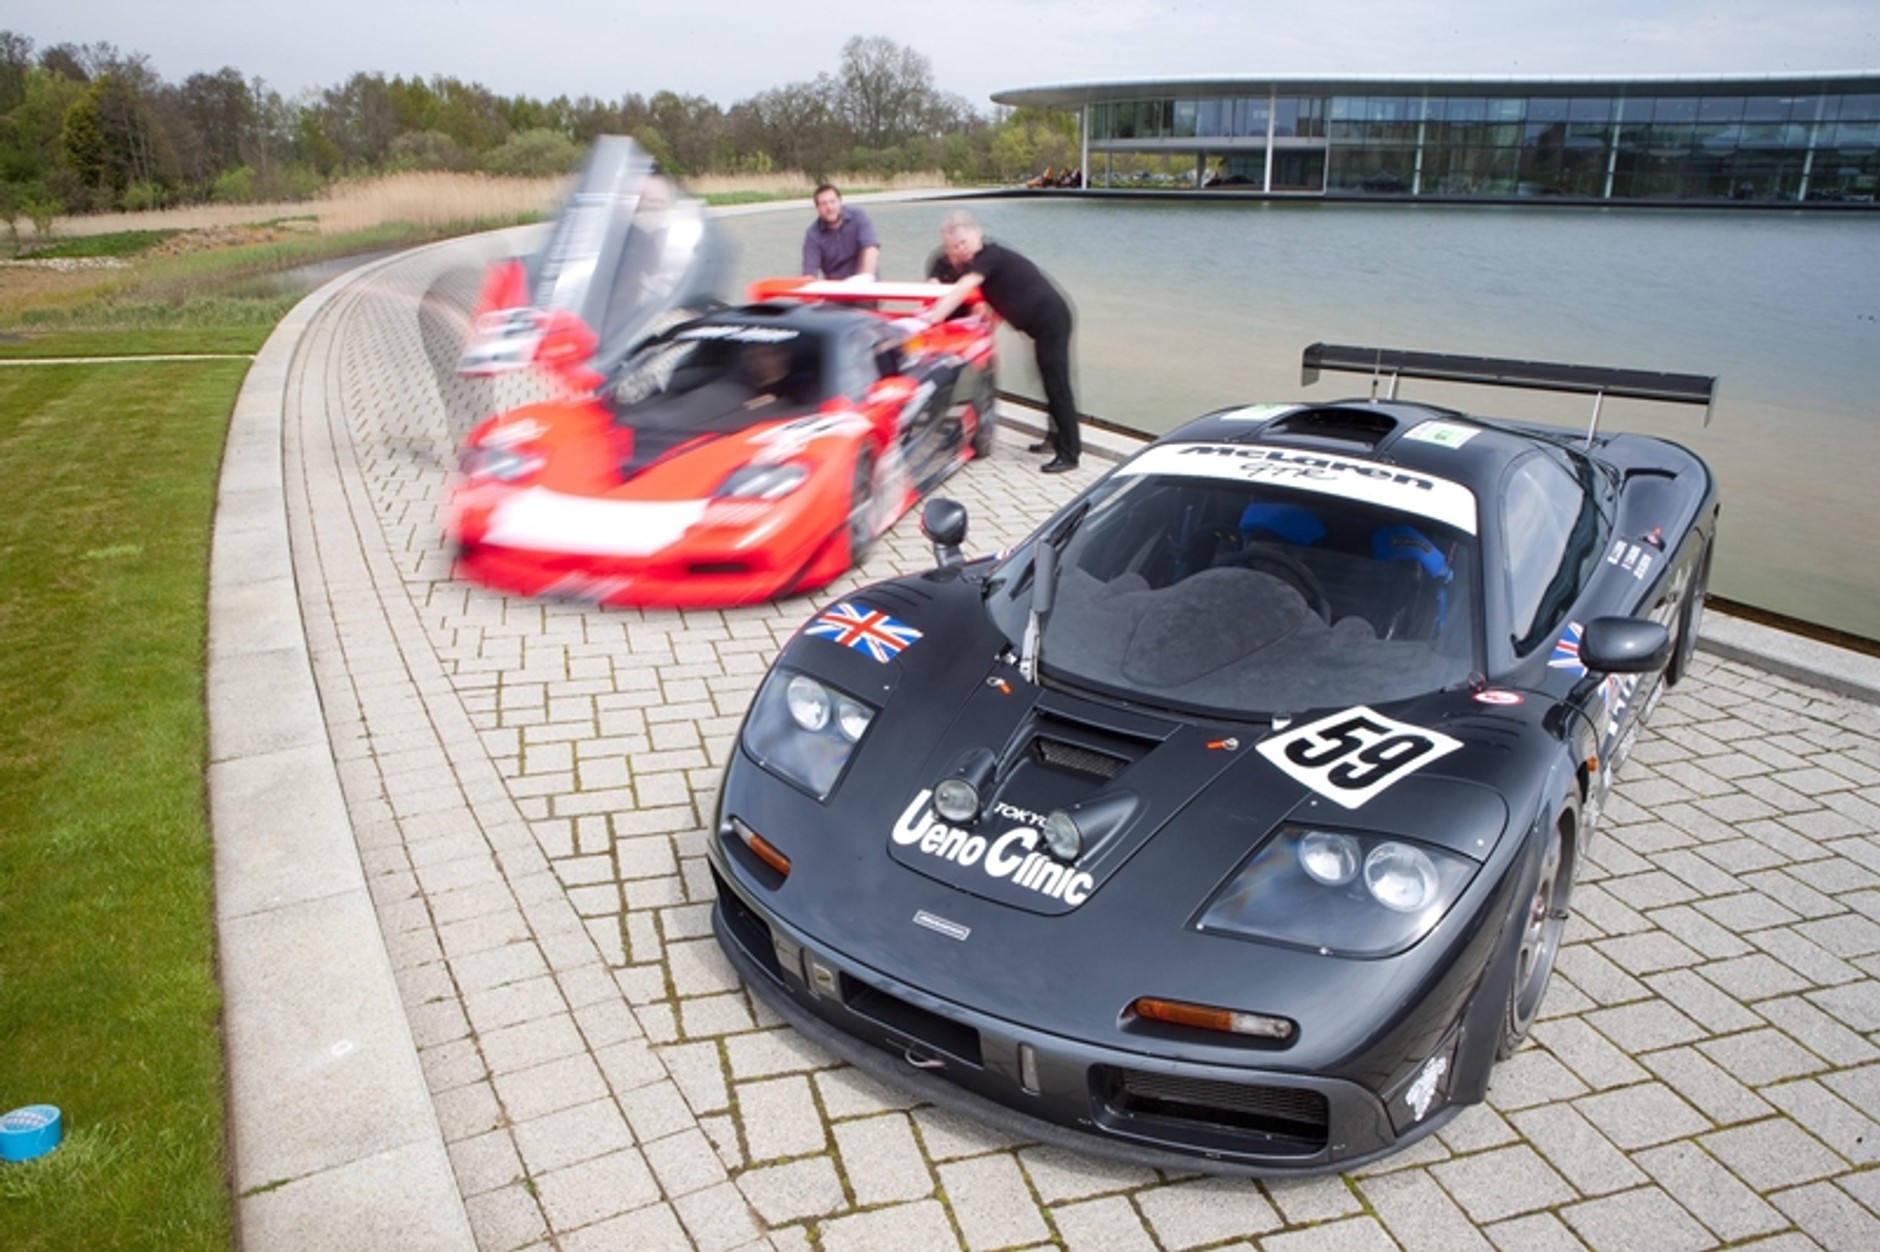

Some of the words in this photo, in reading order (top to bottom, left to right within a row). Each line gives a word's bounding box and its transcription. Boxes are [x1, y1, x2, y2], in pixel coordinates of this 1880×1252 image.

[1177, 445, 1435, 491] McLaren
[1284, 716, 1436, 790] 59
[892, 788, 987, 866] Ueno
[984, 826, 1095, 906] Clinic
